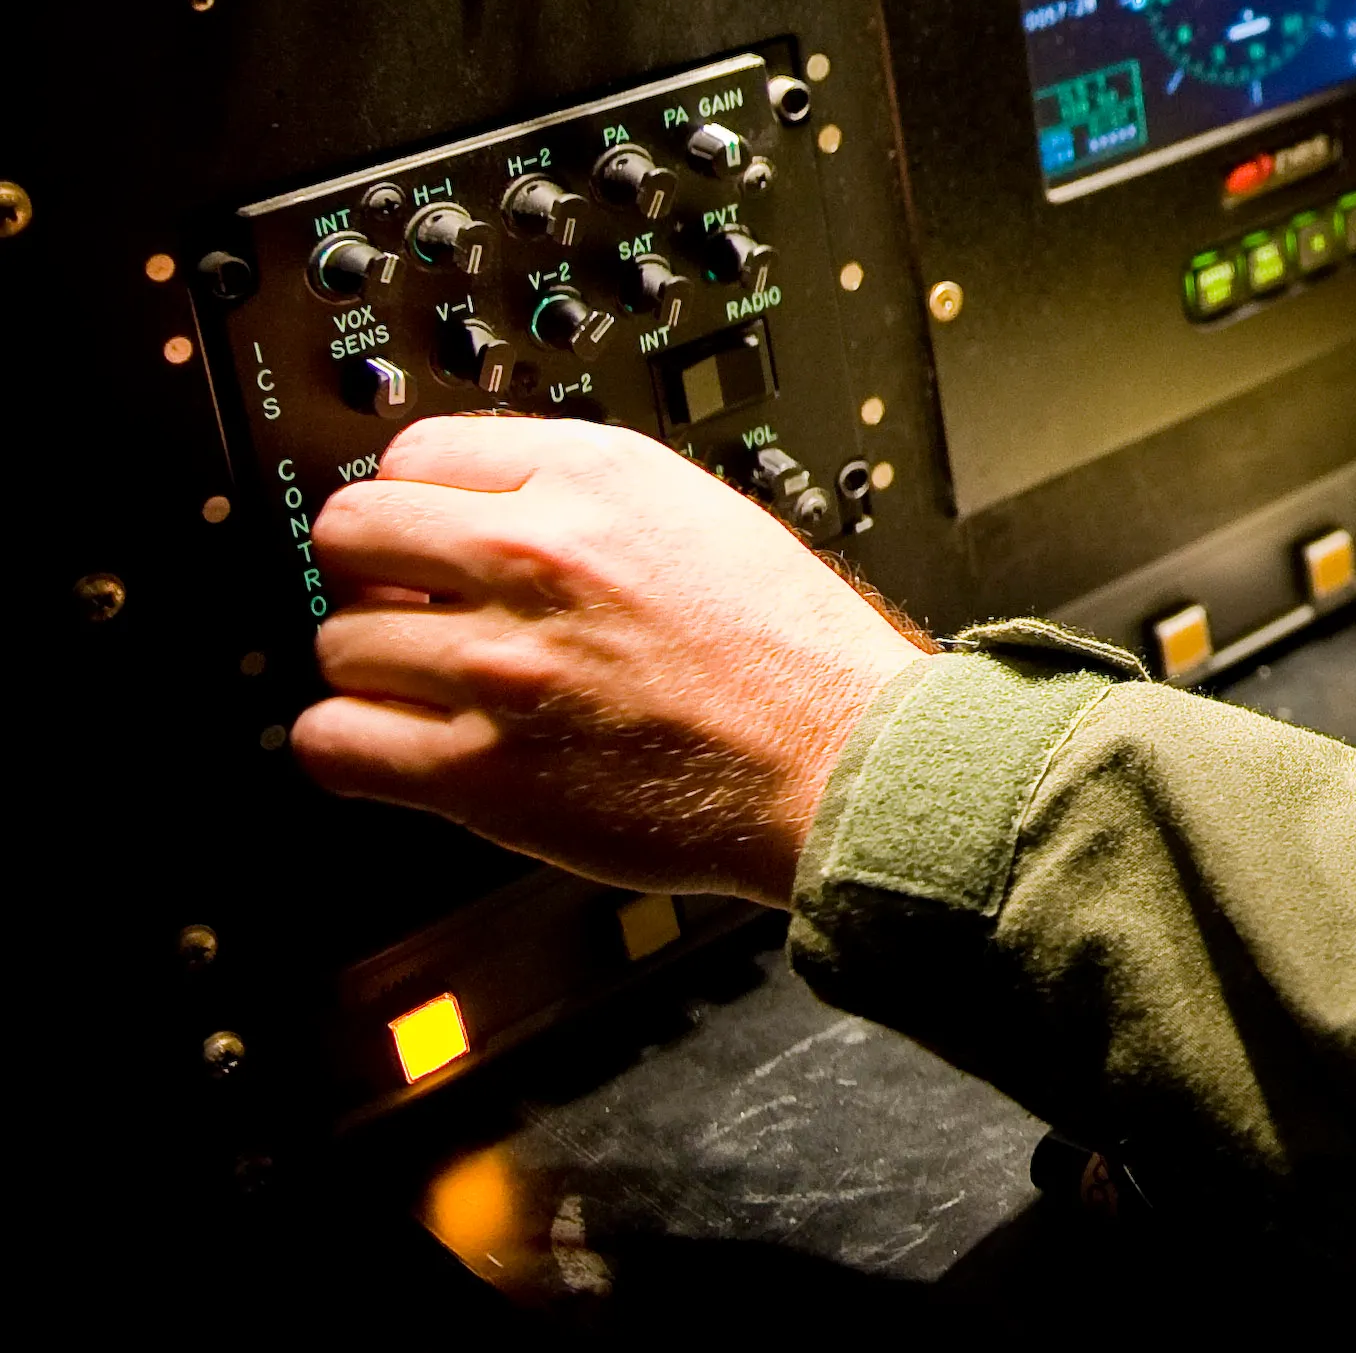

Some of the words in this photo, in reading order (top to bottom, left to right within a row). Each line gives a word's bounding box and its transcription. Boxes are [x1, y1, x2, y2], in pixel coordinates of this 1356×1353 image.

[663, 105, 689, 130] PA
[698, 87, 744, 118] GAIN
[603, 124, 630, 148] PA
[507, 147, 551, 177] H-2
[314, 208, 350, 237] INT
[703, 203, 738, 233] PVT
[618, 232, 654, 261] SAT
[528, 262, 571, 291] V-2
[725, 284, 782, 323] RADIO
[333, 304, 376, 333] VOX
[330, 324, 390, 360] SENS
[639, 325, 670, 354] INT
[549, 372, 592, 404] U-2
[742, 424, 778, 450] VOL
[338, 453, 380, 483] VOX
